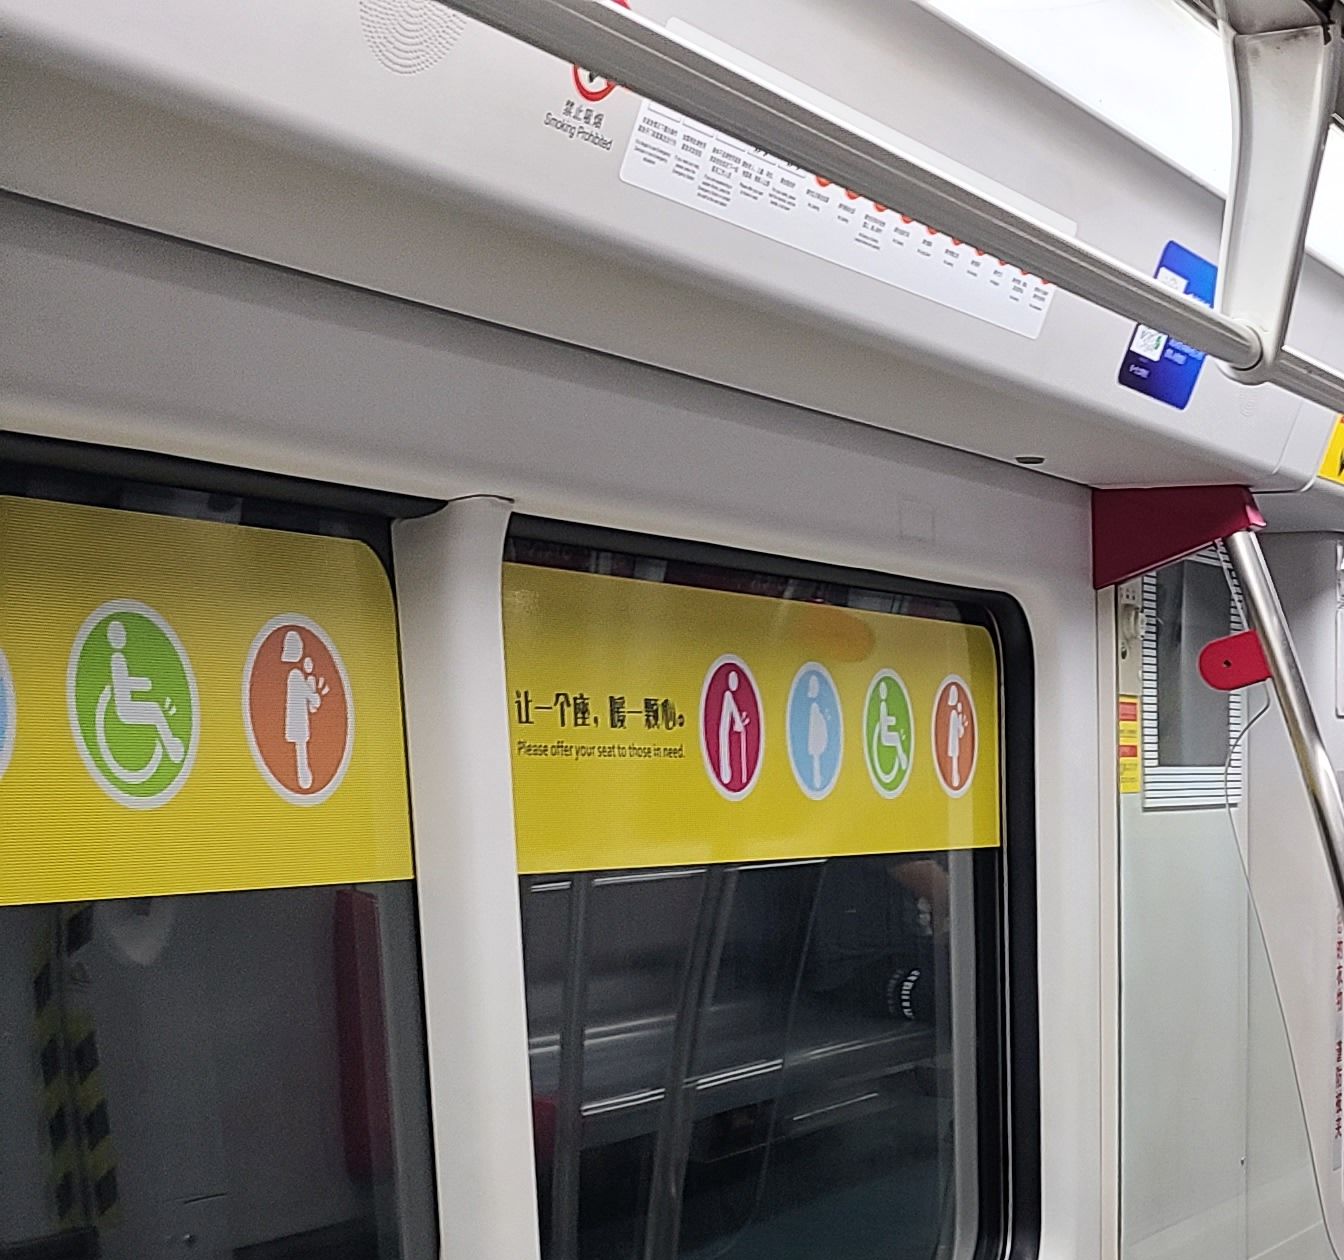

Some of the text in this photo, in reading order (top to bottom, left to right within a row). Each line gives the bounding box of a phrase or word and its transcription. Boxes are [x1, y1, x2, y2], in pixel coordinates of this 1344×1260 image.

[563, 100, 604, 129] 禁止吸烟
[544, 112, 613, 151] Smoking Prohibited
[517, 740, 548, 756] Please
[550, 740, 574, 756] offer
[575, 744, 596, 761] your
[597, 744, 616, 758] seat
[617, 744, 626, 758] to
[628, 742, 652, 758] those
[653, 743, 661, 758] in
